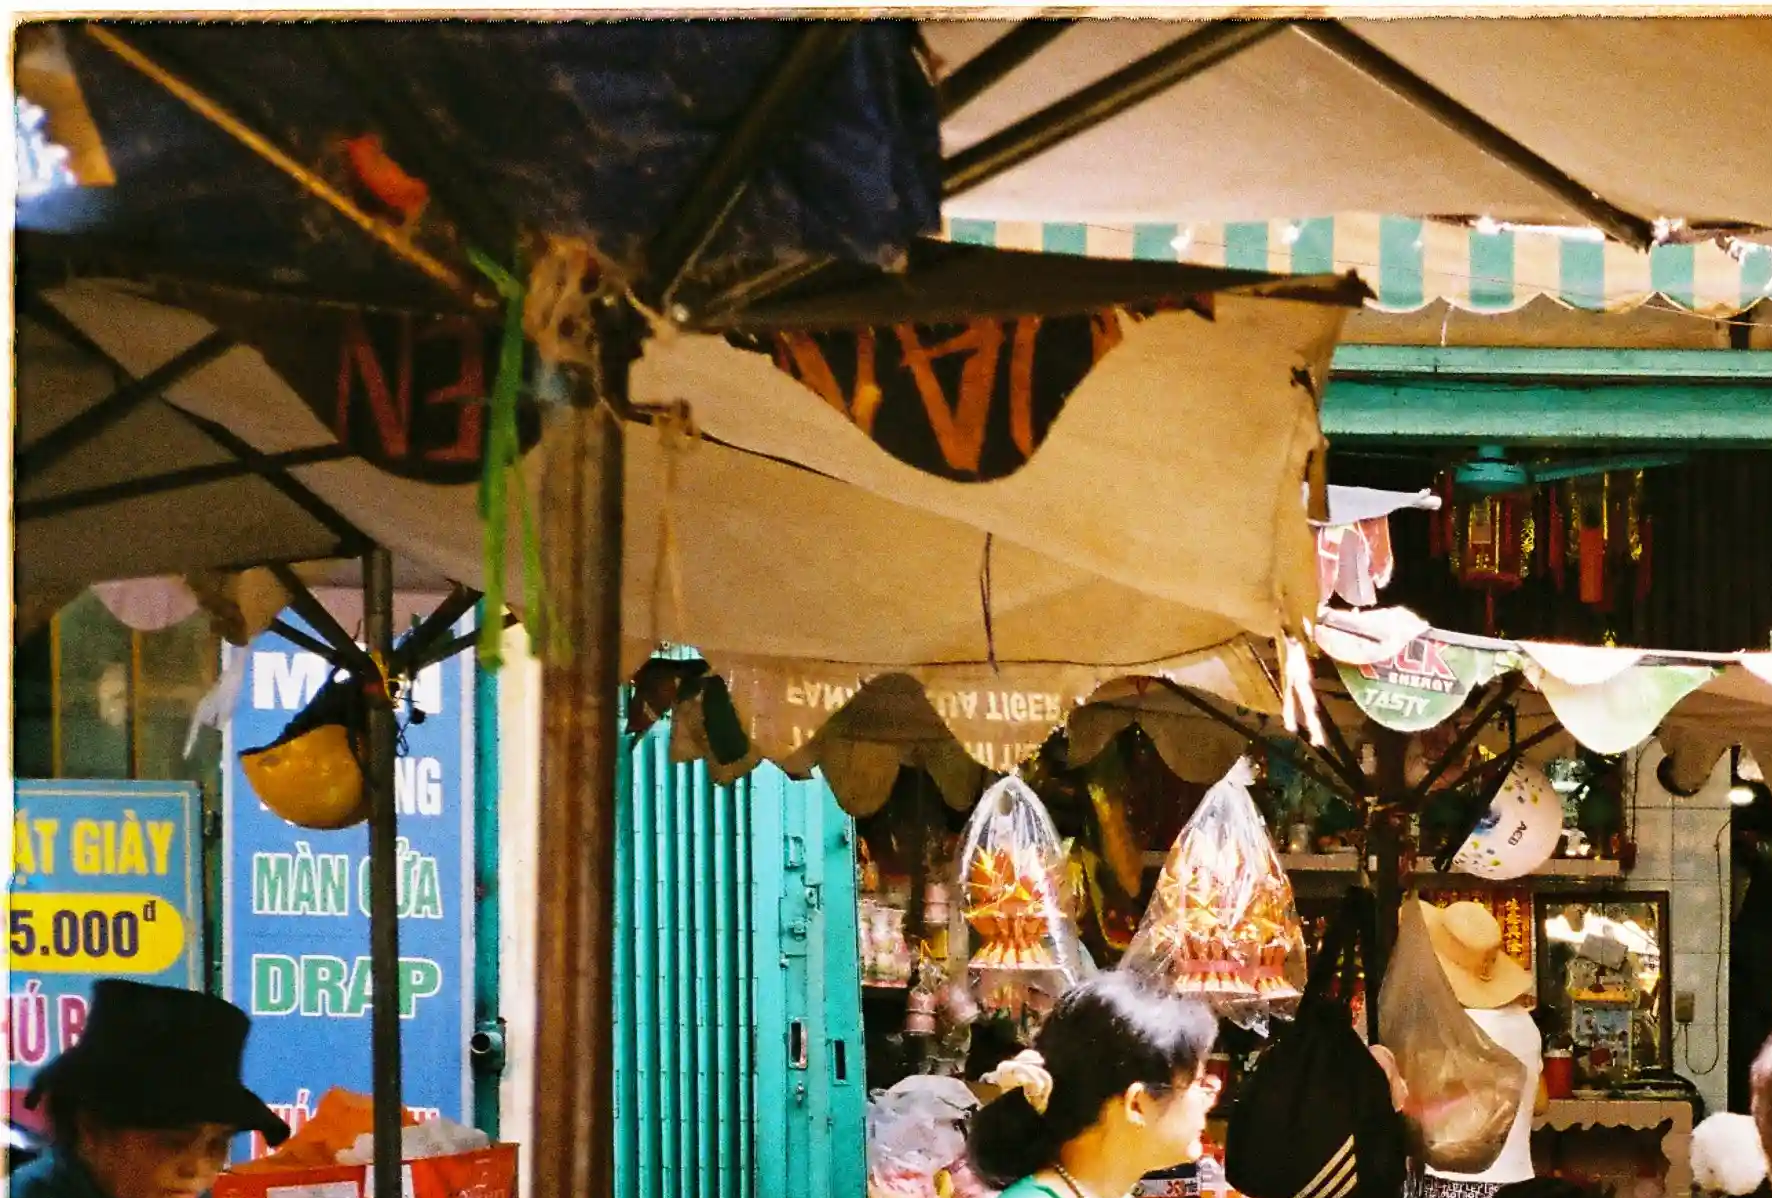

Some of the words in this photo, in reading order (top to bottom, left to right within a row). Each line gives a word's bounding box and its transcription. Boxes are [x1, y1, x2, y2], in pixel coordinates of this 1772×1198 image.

[1364, 688, 1431, 718] TASTY
[71, 808, 175, 876] GIÀY
[253, 841, 349, 916] MÀN
[252, 954, 443, 1018] DRAP
